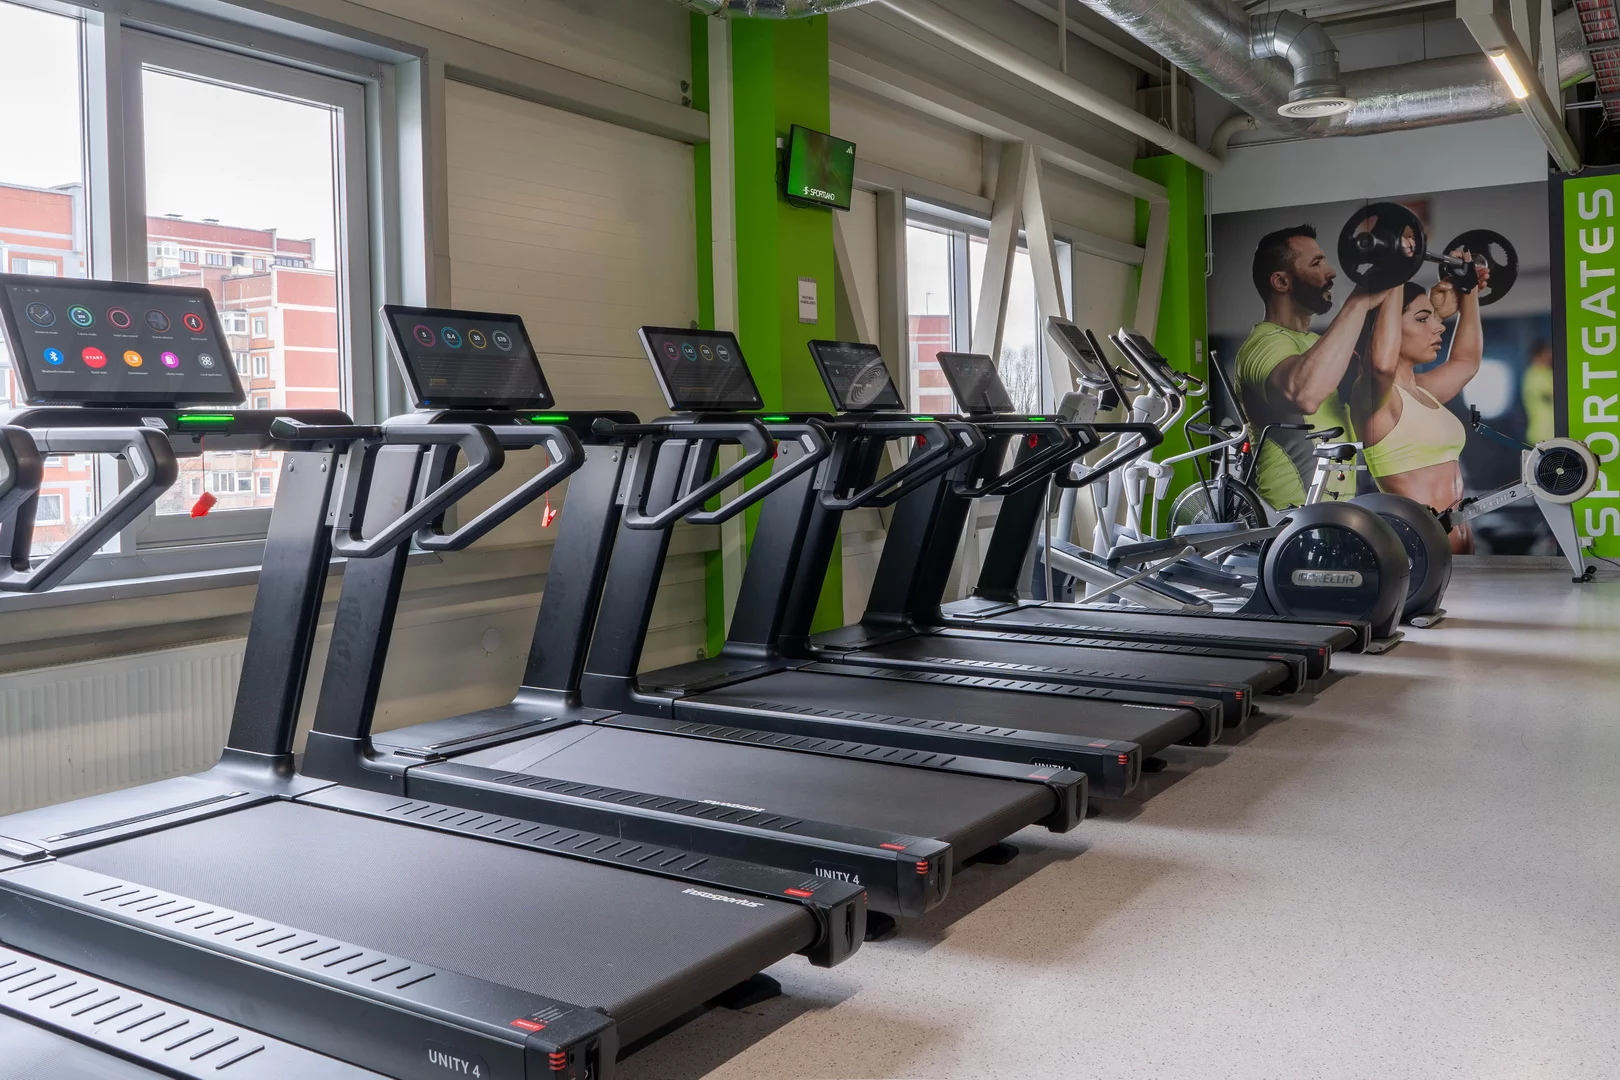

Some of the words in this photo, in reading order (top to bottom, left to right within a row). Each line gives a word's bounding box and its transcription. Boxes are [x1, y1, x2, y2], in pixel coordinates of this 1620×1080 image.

[1578, 188, 1620, 537] SPORTGATES
[815, 867, 850, 883] UNITY
[852, 875, 860, 885] 4
[428, 1048, 469, 1075] UNITY
[472, 1064, 481, 1079] 4
